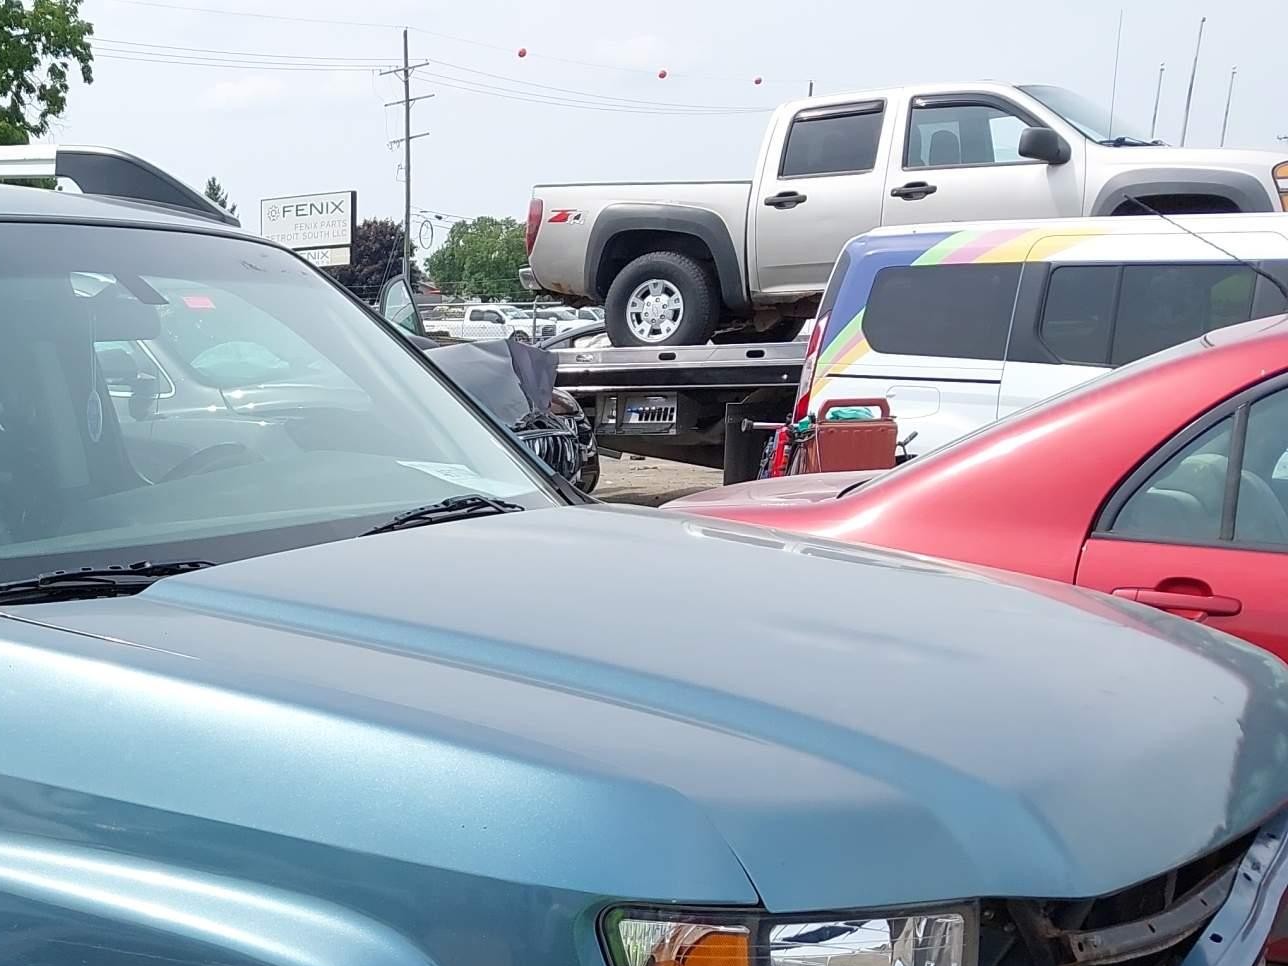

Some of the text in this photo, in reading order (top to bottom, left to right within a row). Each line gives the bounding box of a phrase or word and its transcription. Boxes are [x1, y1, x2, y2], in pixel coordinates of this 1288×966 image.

[283, 200, 344, 218] FENIX
[294, 219, 347, 232] FENIX PARTS
[302, 230, 330, 240] SOUTH
[332, 228, 347, 238] LLC
